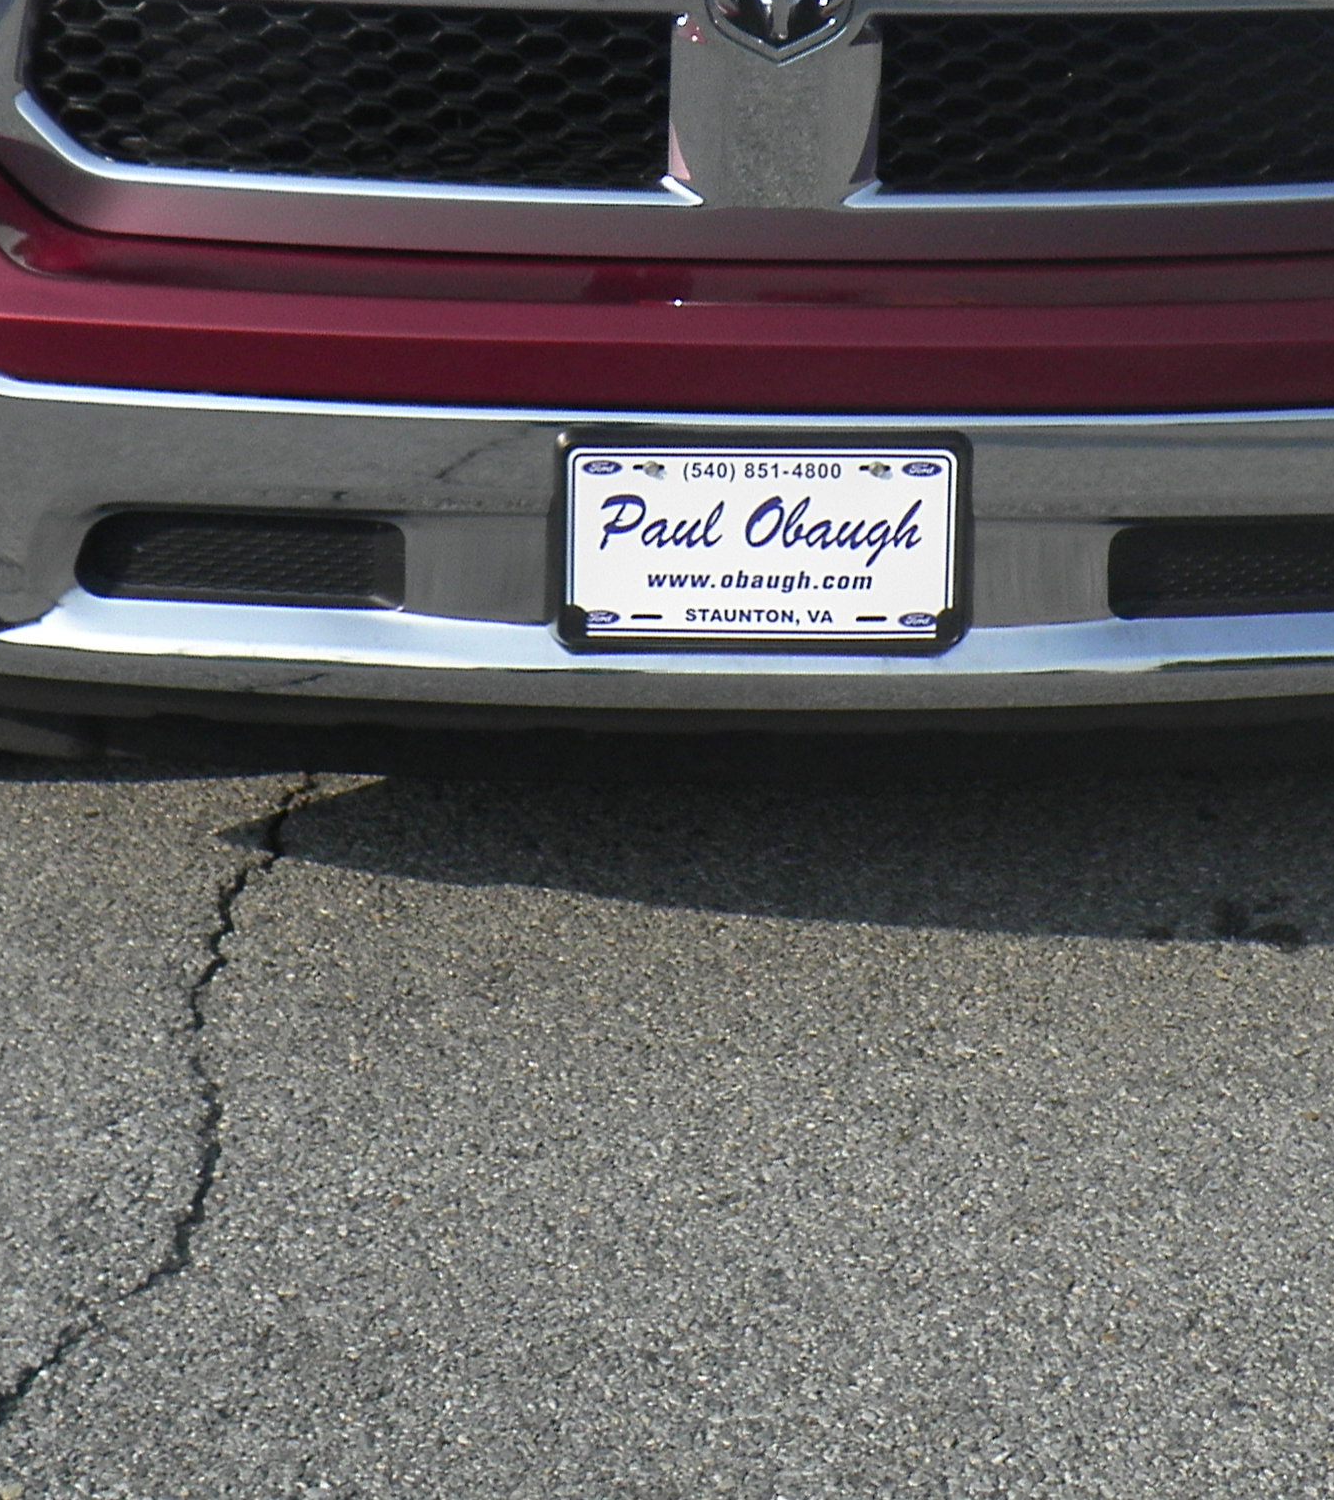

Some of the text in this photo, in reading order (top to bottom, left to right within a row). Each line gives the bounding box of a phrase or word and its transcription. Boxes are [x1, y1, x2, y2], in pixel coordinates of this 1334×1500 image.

[682, 462, 842, 482] (540) 851-4800
[600, 494, 923, 568] Paul Obaugh
[646, 571, 873, 594] www.obaugh.com
[685, 609, 834, 626] STAUNTON, VA
